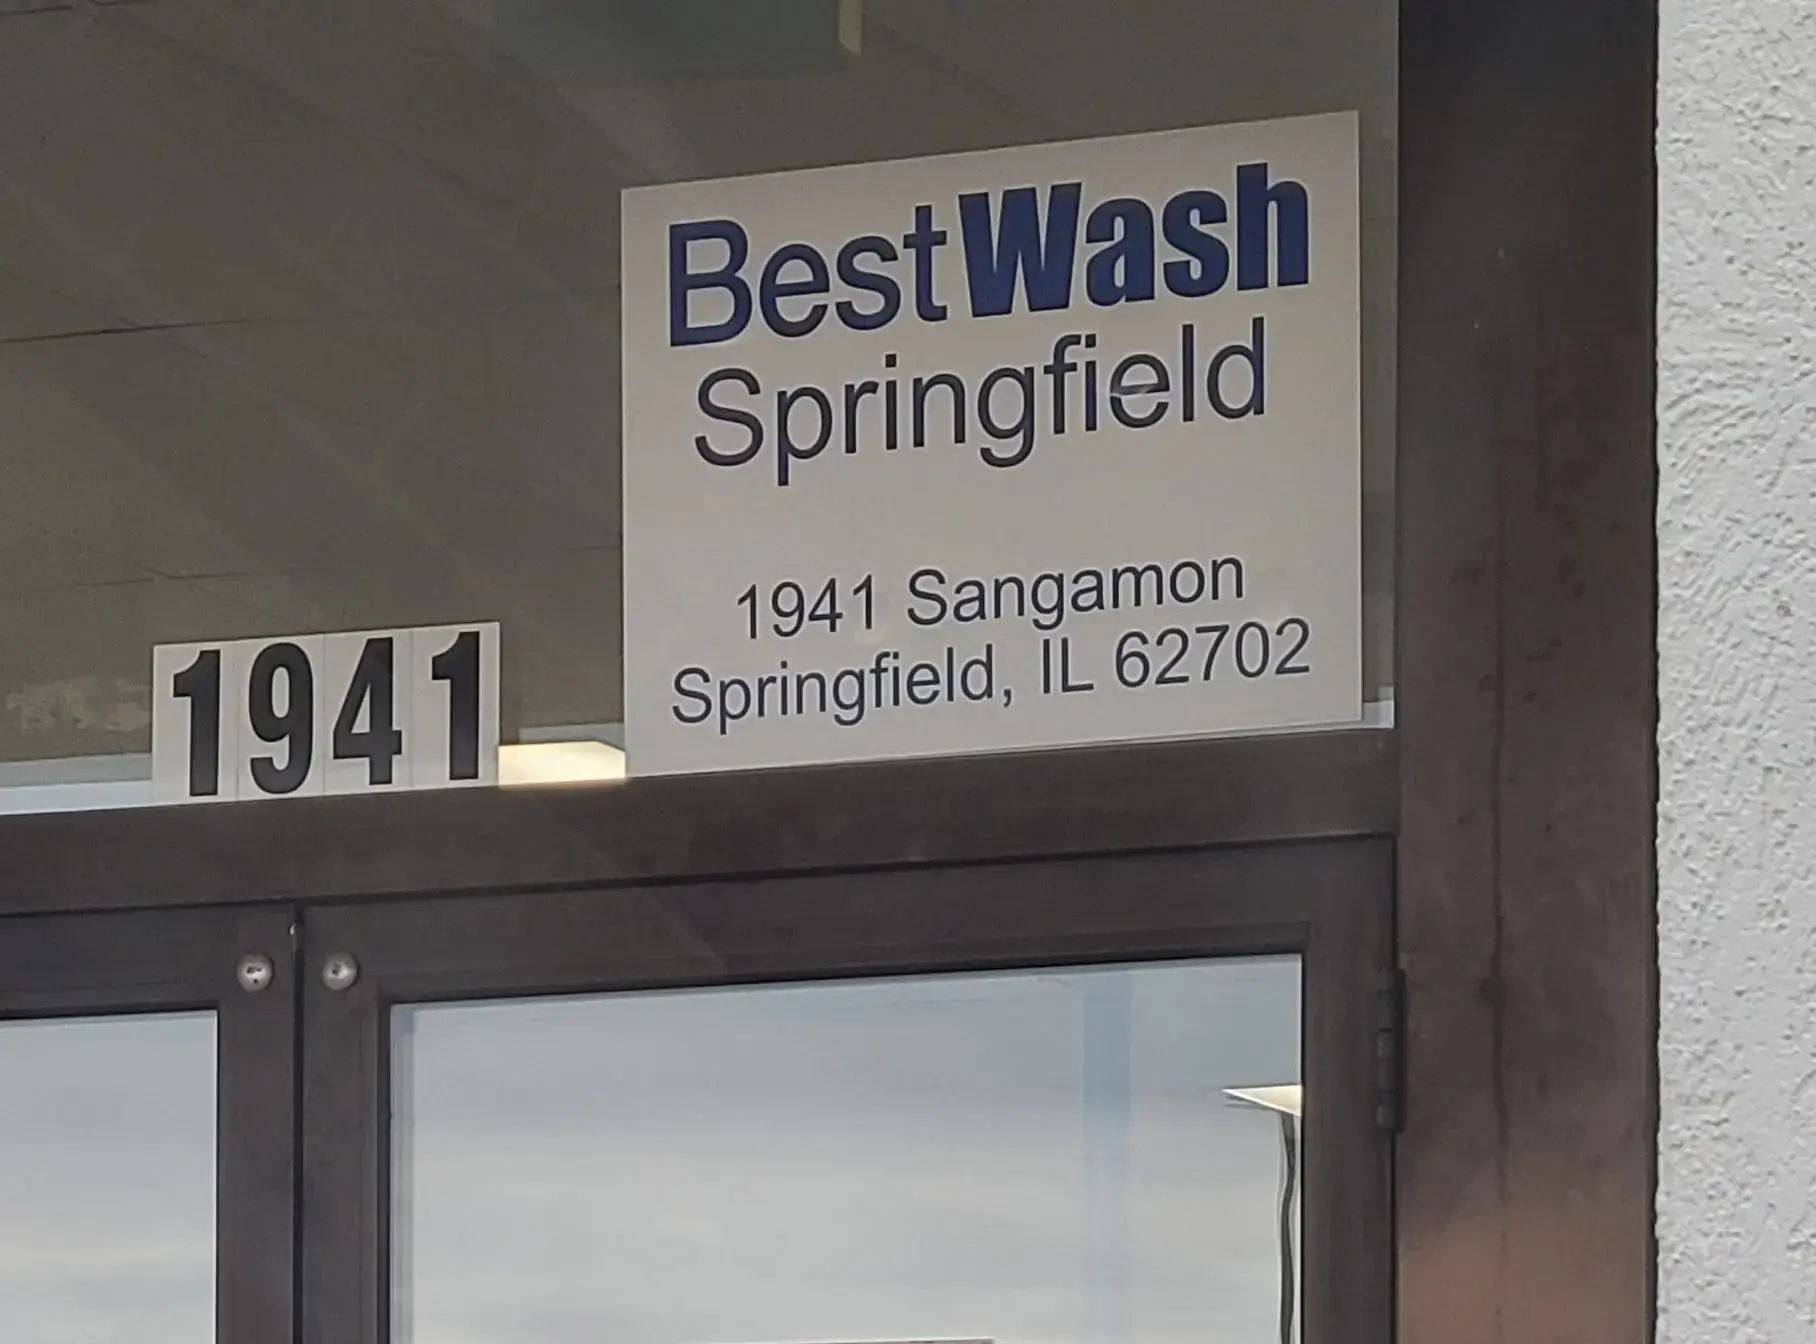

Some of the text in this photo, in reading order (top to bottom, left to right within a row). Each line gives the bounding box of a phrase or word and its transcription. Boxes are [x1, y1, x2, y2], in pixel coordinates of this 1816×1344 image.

[670, 163, 1309, 346] BestWash
[694, 317, 1265, 487] Springfield
[672, 617, 1310, 734] Springfield, IL 62702
[736, 555, 1244, 640] 1941 Sangamon
[173, 630, 480, 797] 1941
